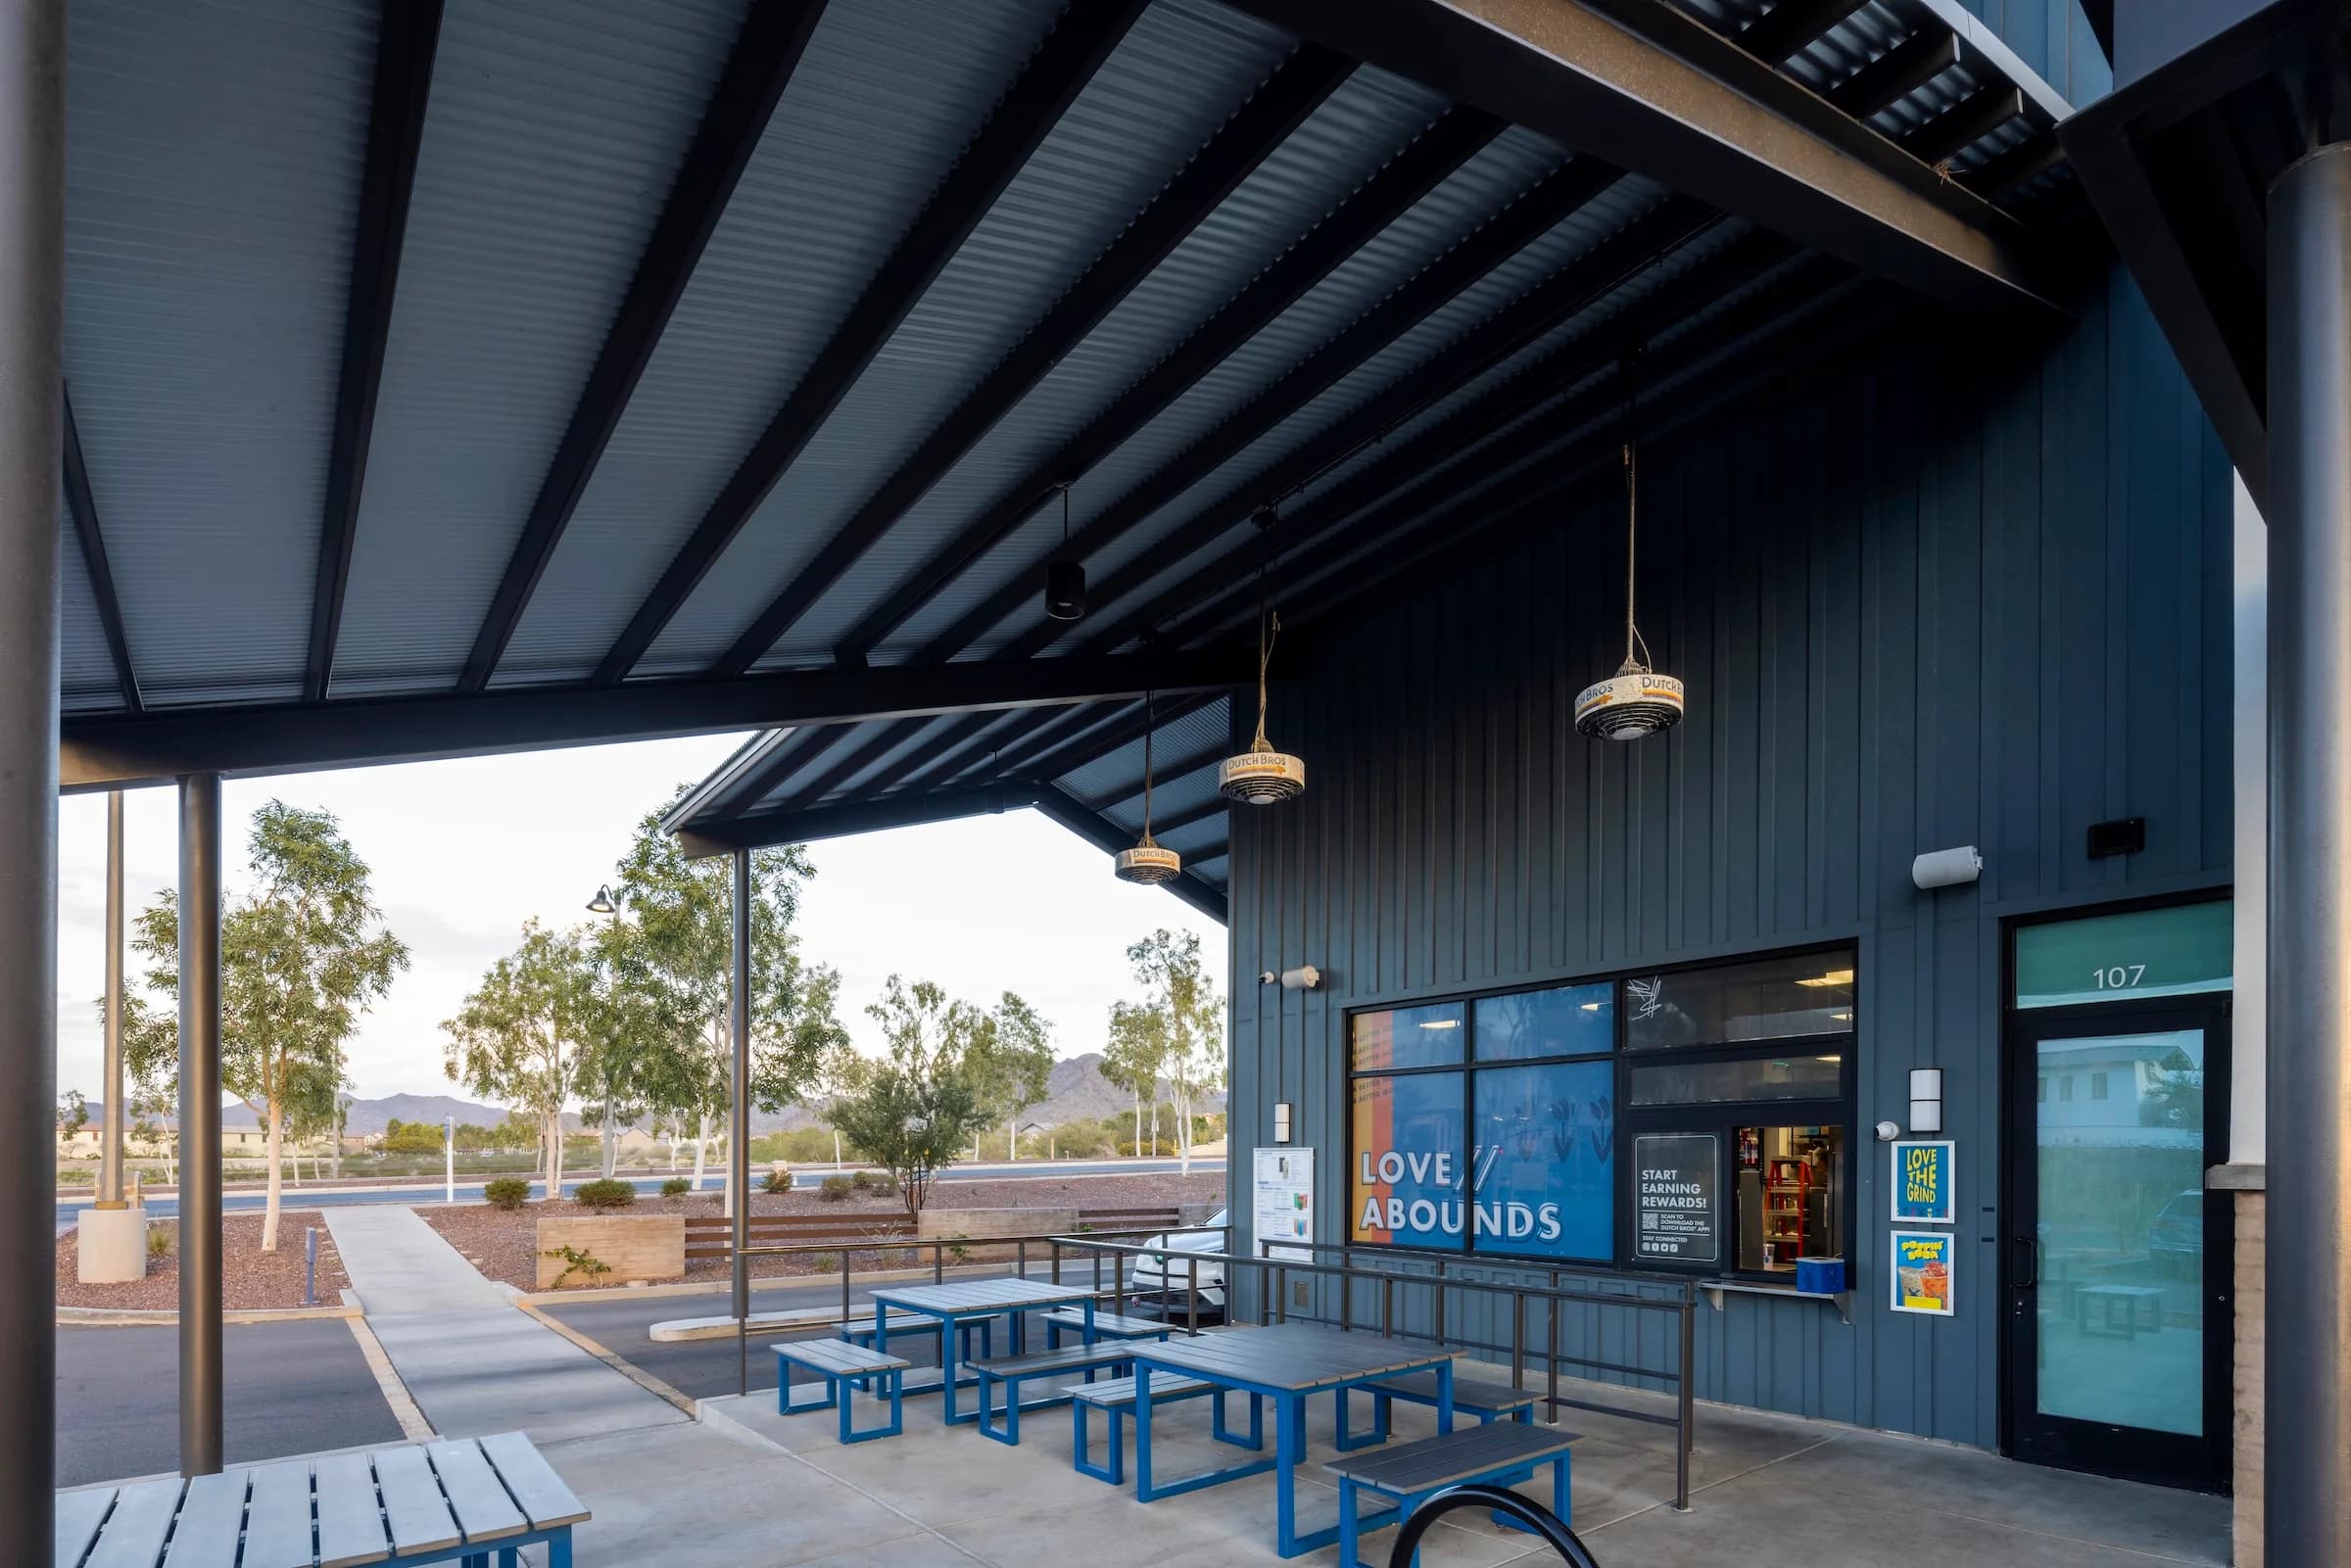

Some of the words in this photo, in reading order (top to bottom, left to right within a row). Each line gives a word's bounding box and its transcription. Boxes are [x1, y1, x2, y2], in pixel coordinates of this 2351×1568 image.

[2093, 964, 2146, 989] 107
[1361, 1150, 1452, 1186] LOVE
[1906, 1149, 1937, 1170] LOVE
[1642, 1169, 1678, 1180] START
[1907, 1164, 1937, 1189] THE
[1642, 1183, 1702, 1195] EARNING
[1907, 1181, 1937, 1203] GRIND
[1642, 1196, 1706, 1209] REWARDS!
[1359, 1197, 1562, 1243] ABOUNDS
